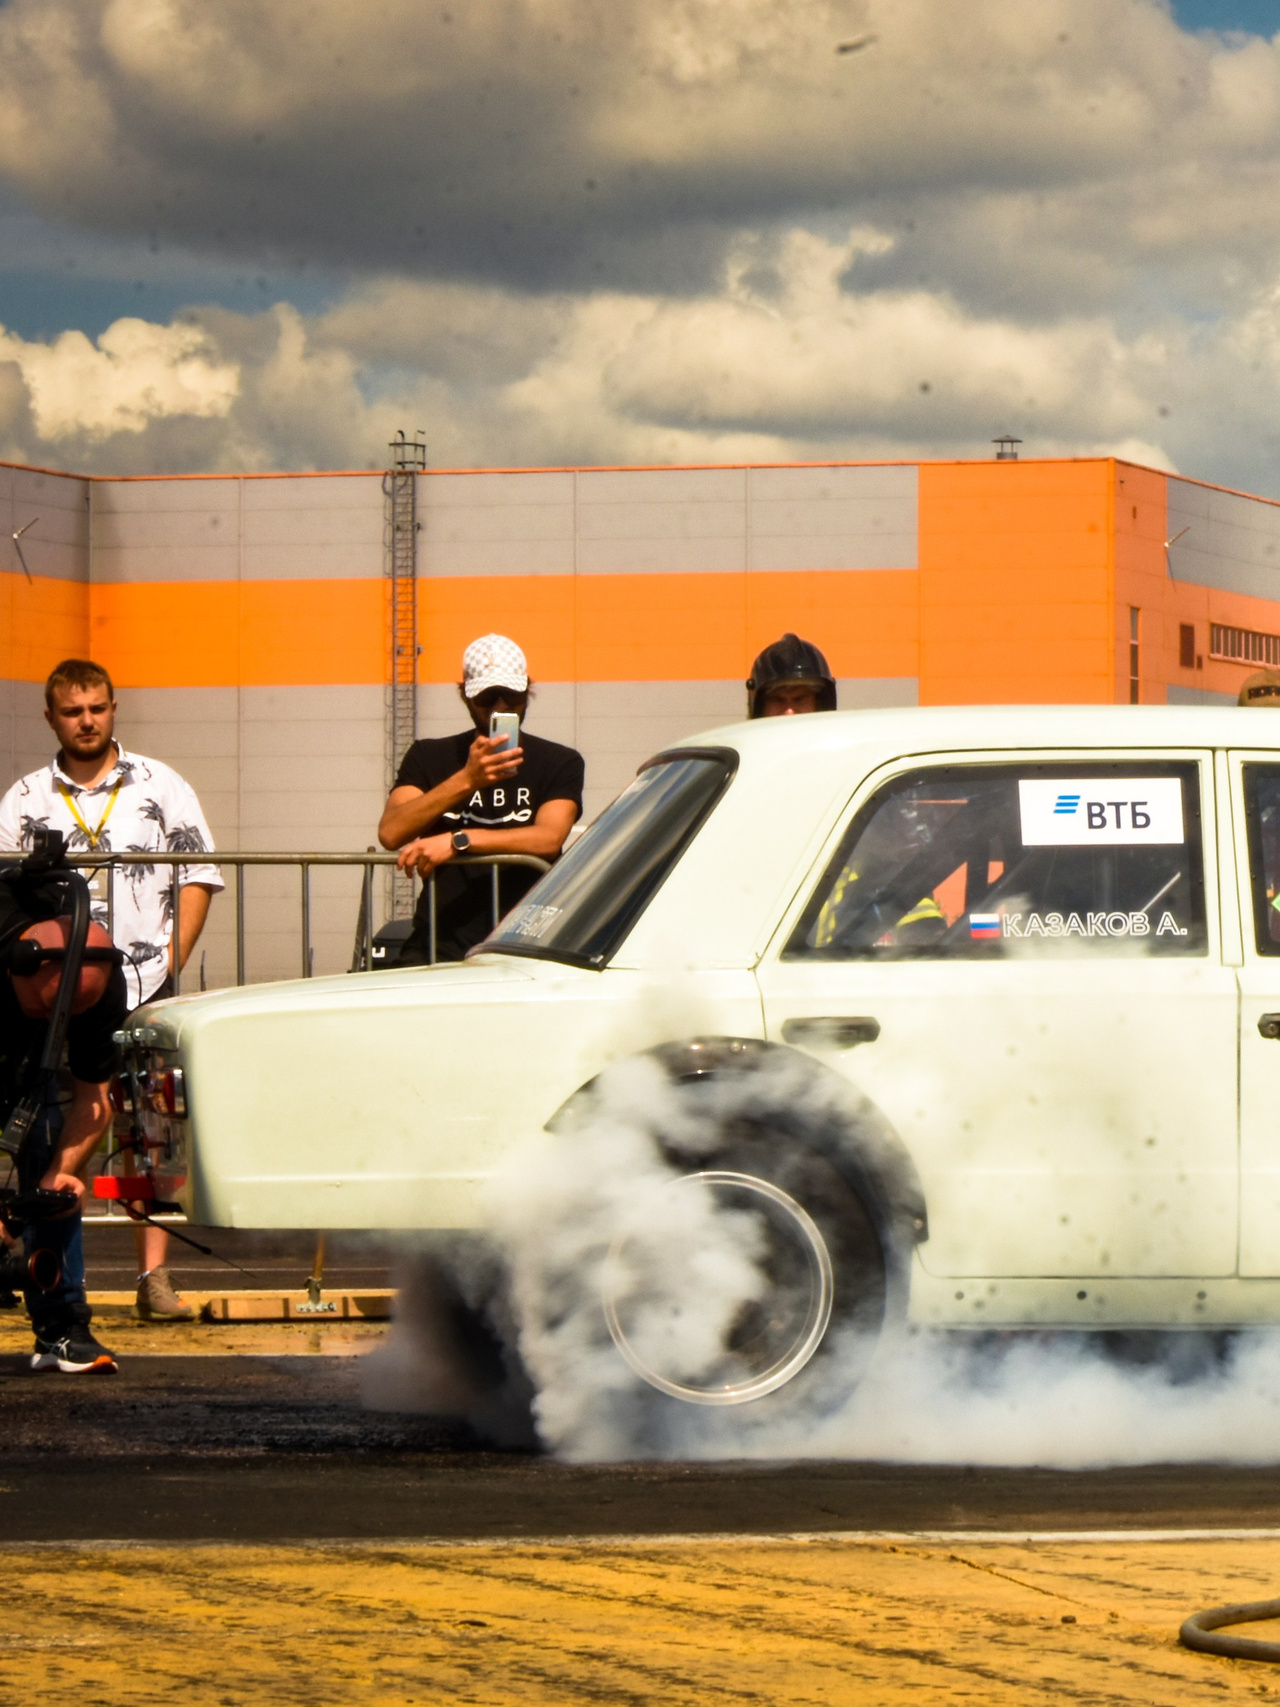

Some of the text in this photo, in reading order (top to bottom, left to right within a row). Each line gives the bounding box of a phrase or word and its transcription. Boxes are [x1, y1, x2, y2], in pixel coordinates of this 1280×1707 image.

[468, 787, 531, 807] ABR
[1086, 801, 1151, 829] ВТБ
[1002, 911, 1188, 938] КАЗАКОВ А.
